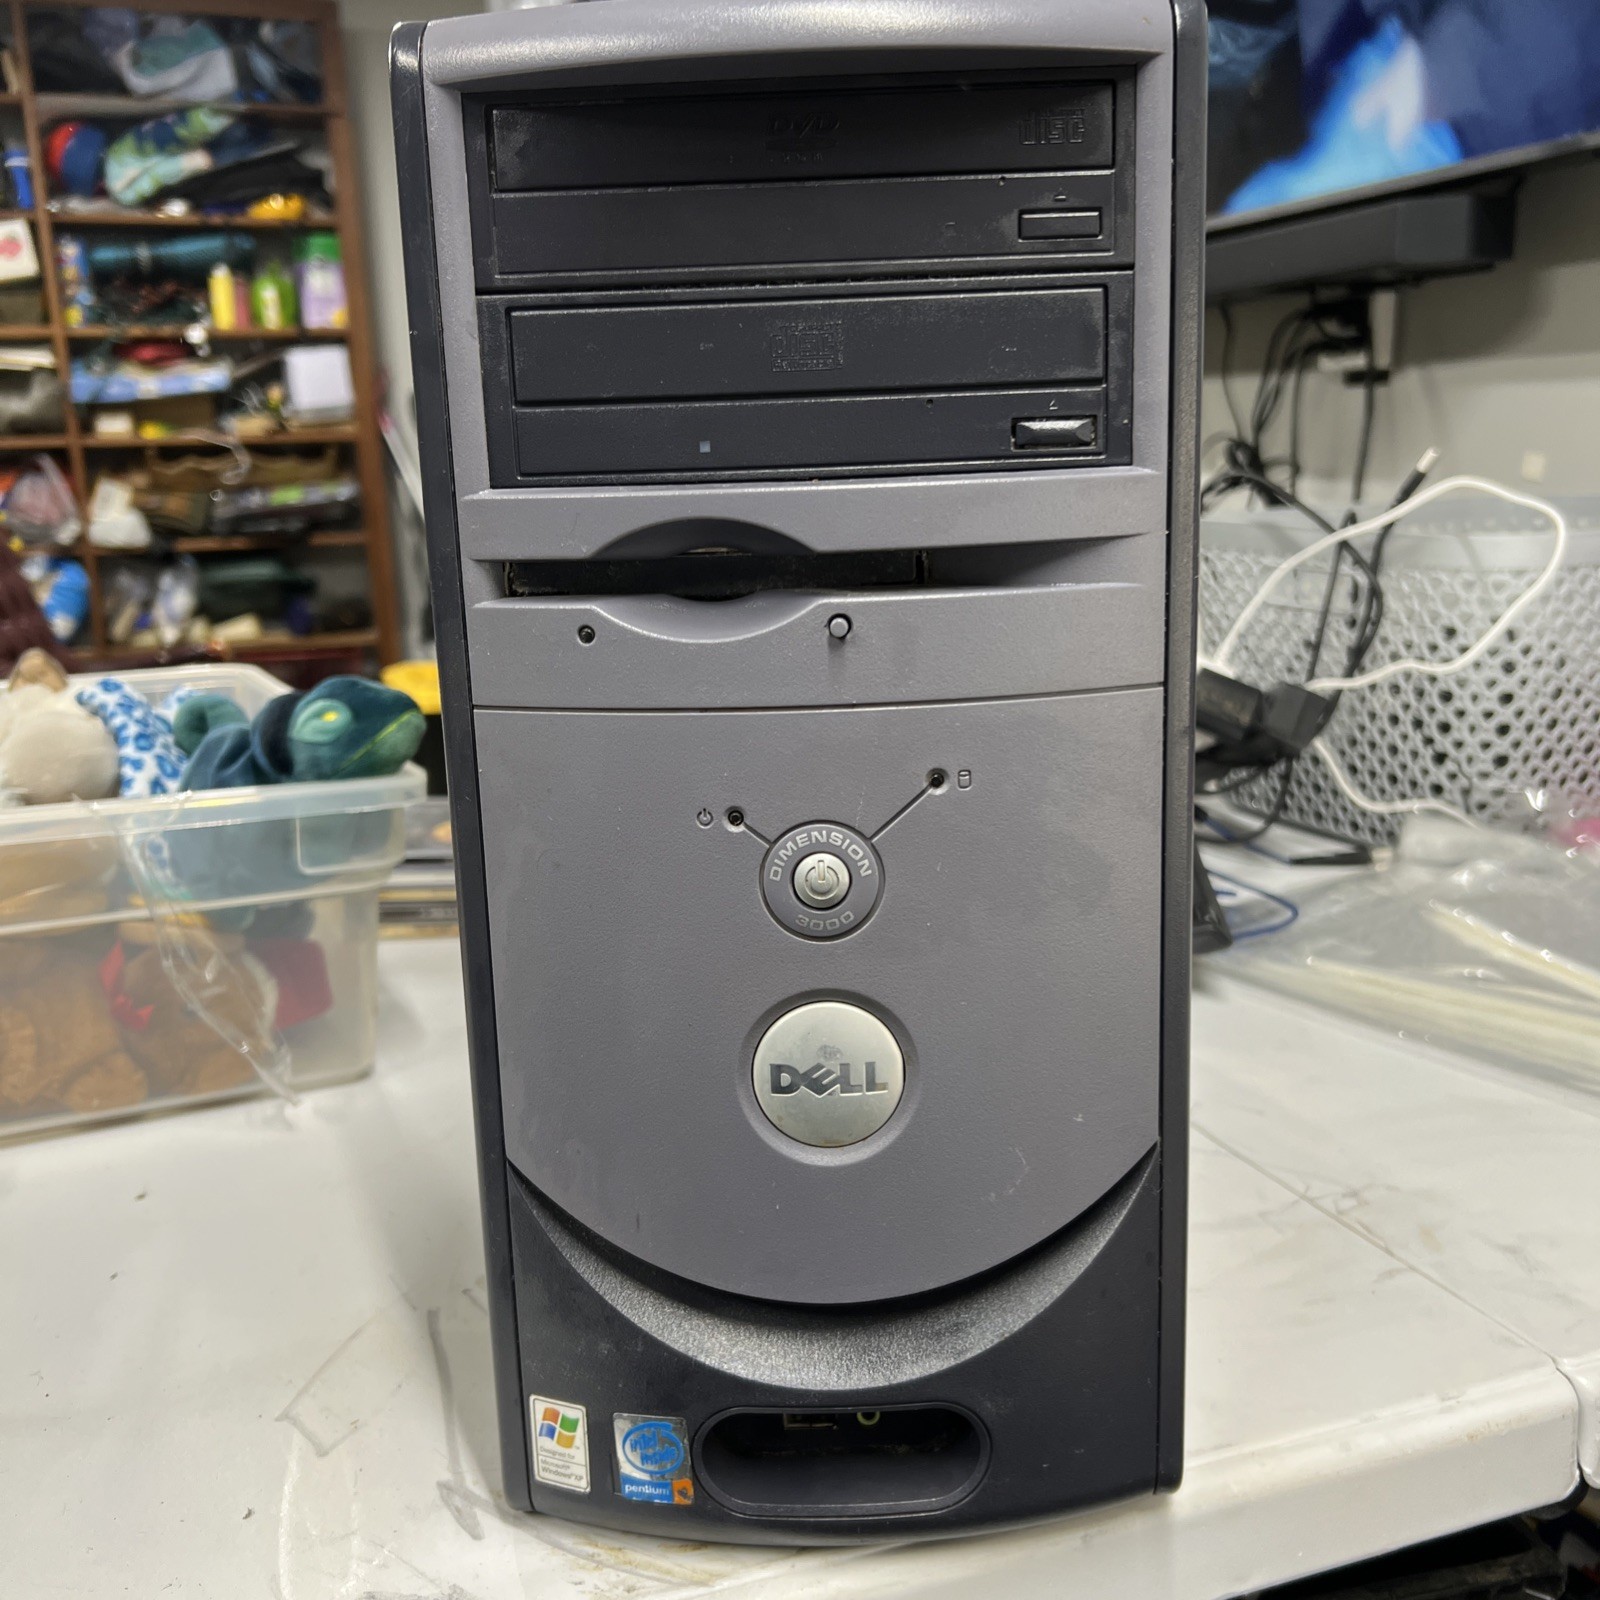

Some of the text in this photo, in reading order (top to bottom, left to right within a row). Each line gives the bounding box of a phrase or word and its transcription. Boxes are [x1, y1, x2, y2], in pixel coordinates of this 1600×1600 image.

[769, 830, 872, 882] DIMENSION
[795, 911, 855, 931] 3000
[769, 1061, 889, 1098] DELL
[624, 1484, 670, 1495] pentium
